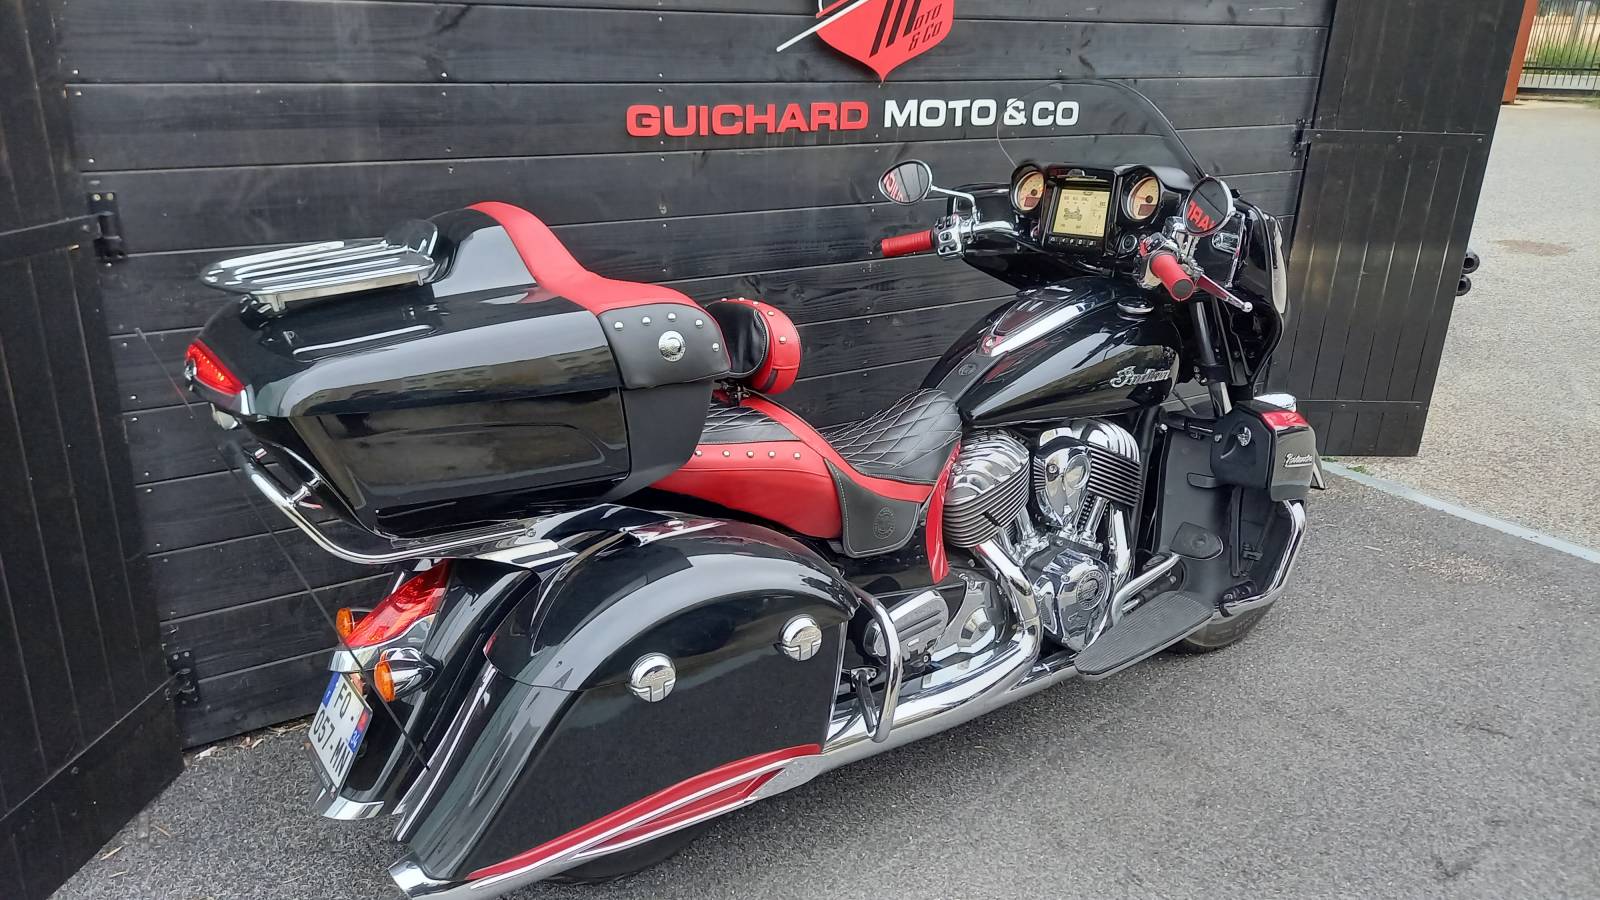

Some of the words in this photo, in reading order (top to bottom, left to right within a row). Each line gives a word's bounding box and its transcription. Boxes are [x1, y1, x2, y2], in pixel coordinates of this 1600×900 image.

[626, 101, 869, 137] GUICHARD
[883, 99, 997, 128] MOTO
[1003, 98, 1027, 126] &
[1031, 102, 1080, 127] CO
